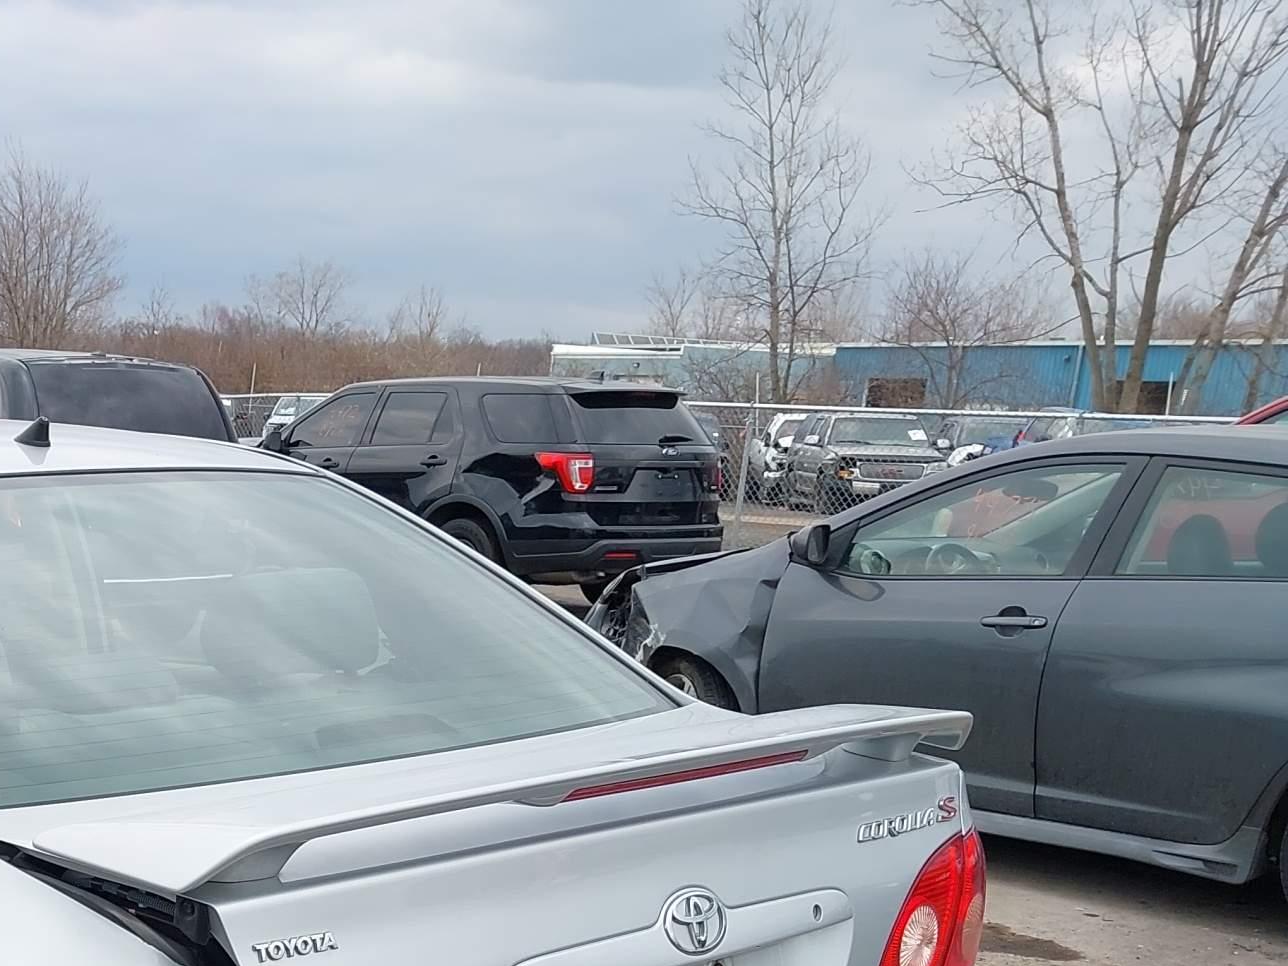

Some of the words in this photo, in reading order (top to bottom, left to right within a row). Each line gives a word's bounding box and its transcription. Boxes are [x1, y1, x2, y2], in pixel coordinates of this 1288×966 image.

[857, 807, 934, 843] COROLLA
[936, 796, 957, 823] S
[252, 931, 339, 963] TOYOTA
